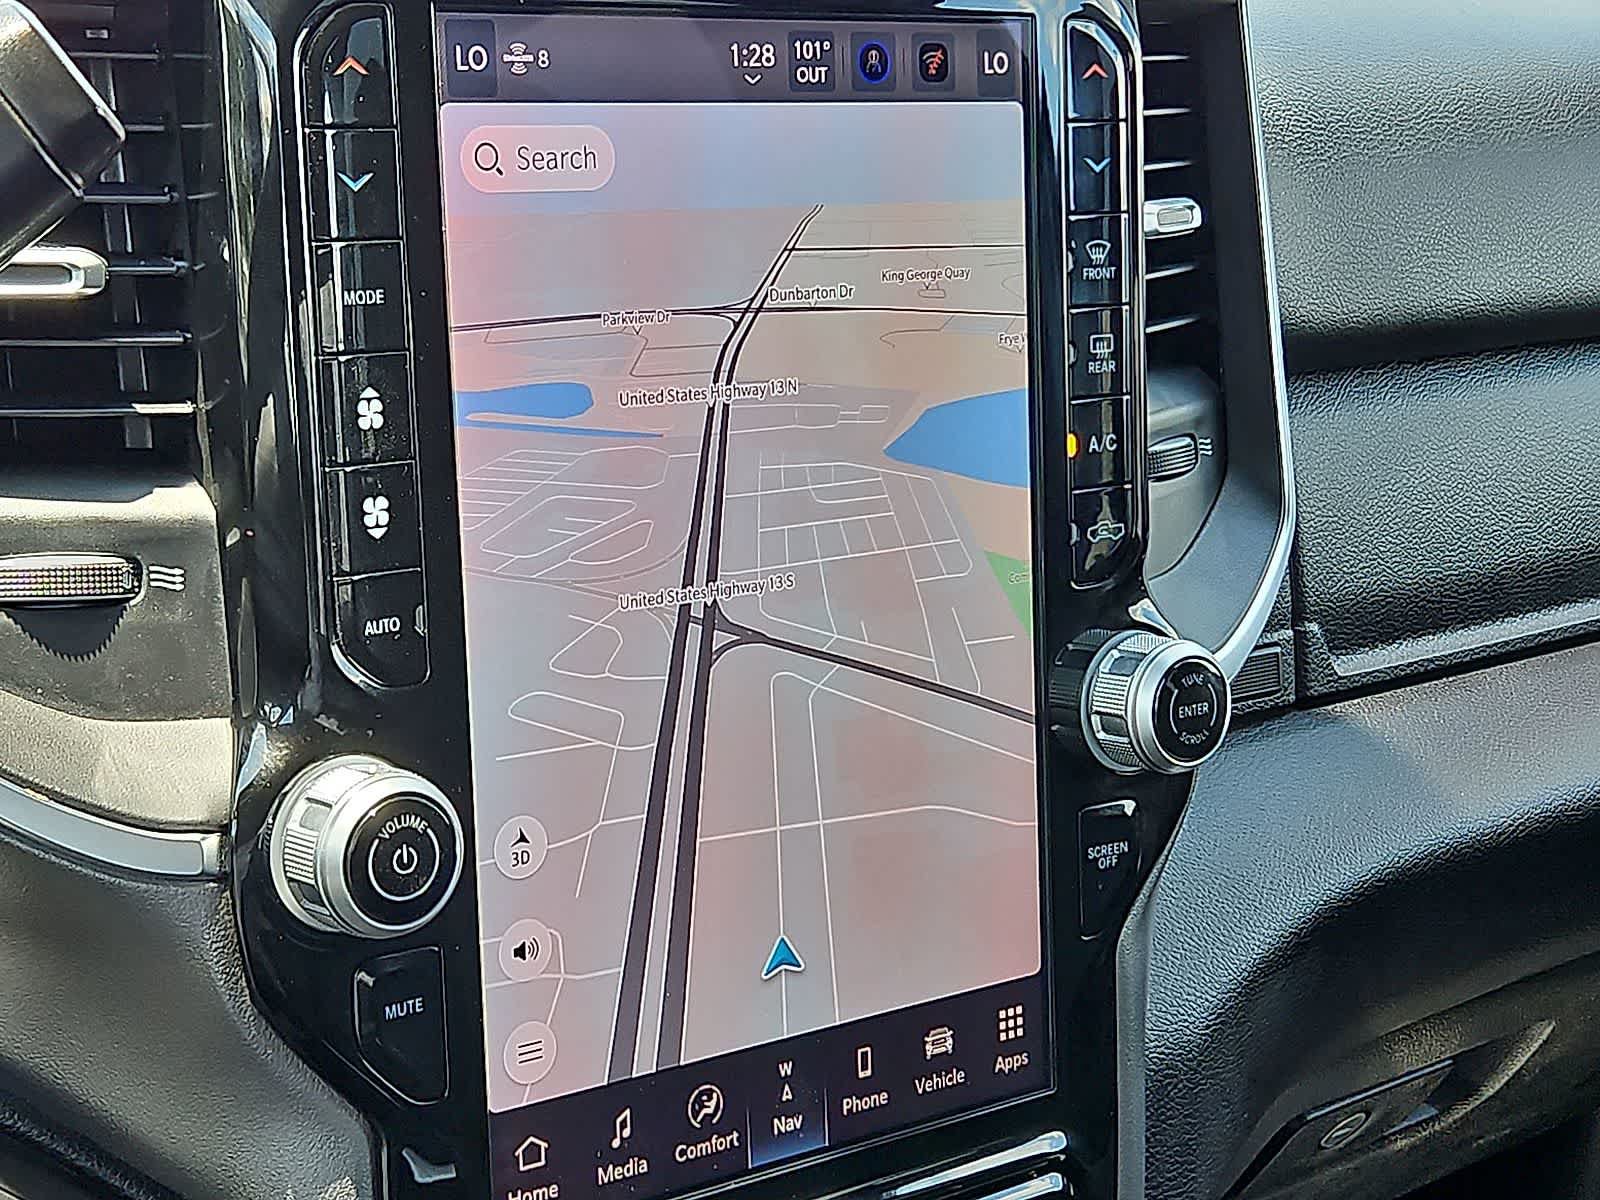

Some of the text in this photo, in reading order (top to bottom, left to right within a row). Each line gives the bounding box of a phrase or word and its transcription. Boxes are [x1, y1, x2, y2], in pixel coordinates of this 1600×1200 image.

[455, 44, 488, 71] LO
[537, 50, 550, 68] 8
[730, 43, 776, 68] 1:28
[983, 51, 1009, 74] LO
[796, 66, 829, 84] OUT
[517, 144, 597, 171] Search
[881, 266, 971, 282] King George Quay
[1082, 267, 1117, 281] FRONT
[343, 289, 385, 306] MODE
[769, 285, 855, 302] Dunbarton Dr
[602, 311, 671, 327] Parkview Dr
[999, 333, 1020, 347] Frye
[1088, 360, 1117, 374] REAR
[618, 378, 799, 407] United States Highway 13 N
[1088, 433, 1118, 453] A/C
[619, 591, 664, 610] United
[666, 586, 706, 603] States
[709, 579, 766, 600] Highway
[364, 616, 401, 637] AUTO
[1181, 672, 1206, 690] TUNE
[1178, 702, 1209, 719] ENTER
[377, 814, 430, 841] VOLUME
[511, 850, 530, 868] 3D
[1087, 841, 1129, 860] SCREEN
[1098, 854, 1119, 870] OFF
[385, 997, 424, 1021] MUTE
[778, 1061, 793, 1077] W
[994, 1051, 1030, 1074] Apps
[915, 1068, 966, 1095] Vehicle
[842, 1090, 889, 1116] Phone
[773, 1113, 803, 1136] Nav
[675, 1130, 740, 1162] Comfort
[597, 1156, 649, 1186] Media
